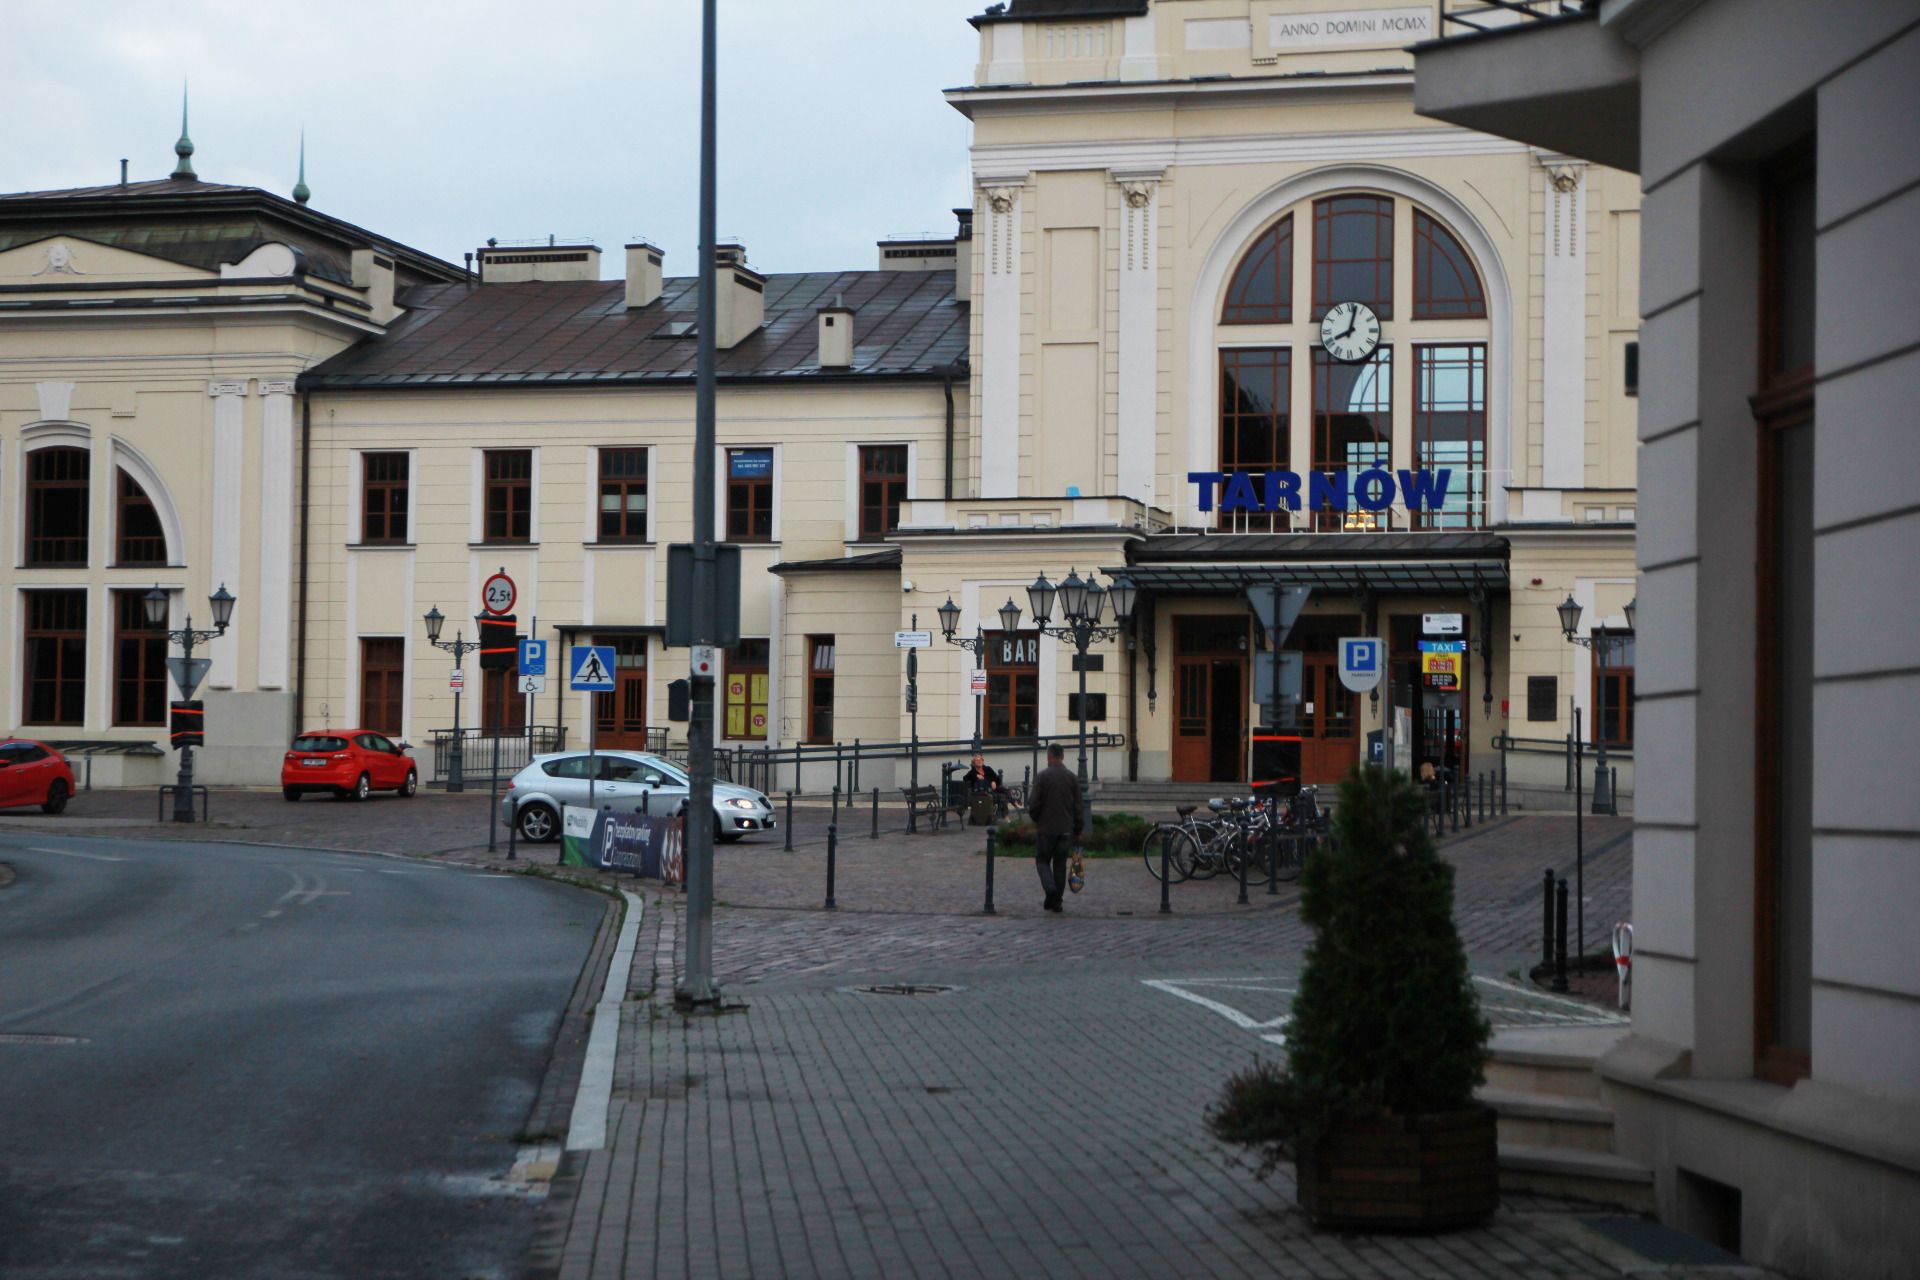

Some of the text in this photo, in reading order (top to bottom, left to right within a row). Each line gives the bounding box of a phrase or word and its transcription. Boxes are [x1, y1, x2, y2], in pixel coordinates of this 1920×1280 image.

[1280, 16, 1426, 36] ANNO DOMINI MCMX
[1188, 459, 1452, 513] TARNÓW
[488, 587, 512, 603] 2,5t
[525, 643, 541, 665] P
[1002, 639, 1037, 663] BAR
[1353, 645, 1370, 668] P
[1431, 642, 1454, 652] TAXI
[1374, 742, 1384, 755] P
